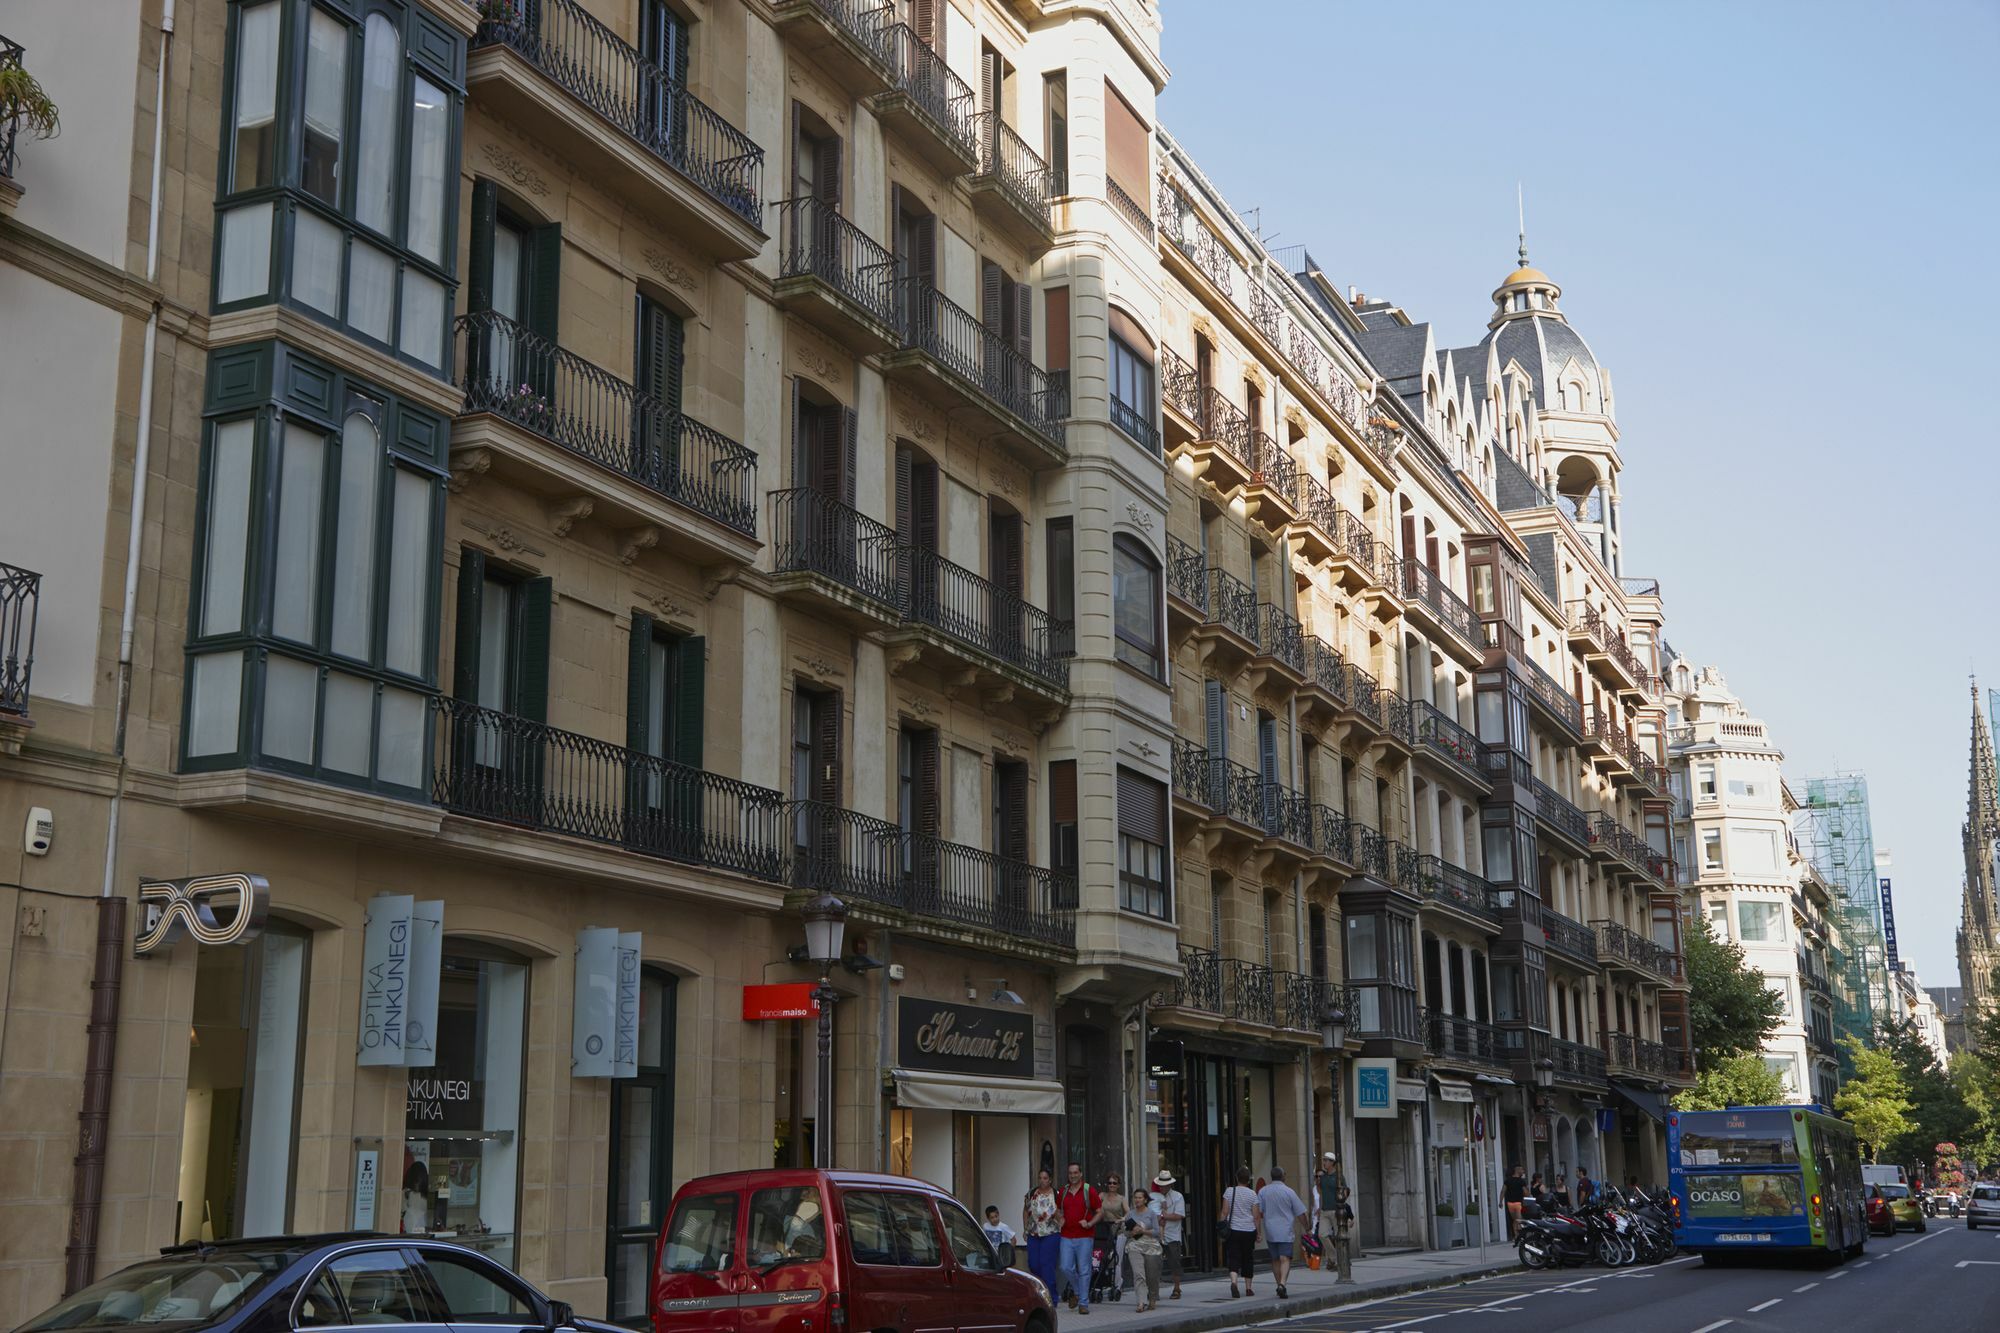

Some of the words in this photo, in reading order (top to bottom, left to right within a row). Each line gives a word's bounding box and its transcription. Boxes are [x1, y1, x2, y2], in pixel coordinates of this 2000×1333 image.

[364, 963, 385, 1048] OPTIKA
[384, 920, 407, 1048] ZINKUNEGI
[916, 1010, 1000, 1059] Hernani
[998, 1030, 1024, 1061] 25
[364, 1160, 372, 1171] E
[1690, 1191, 1741, 1202] OCASO
